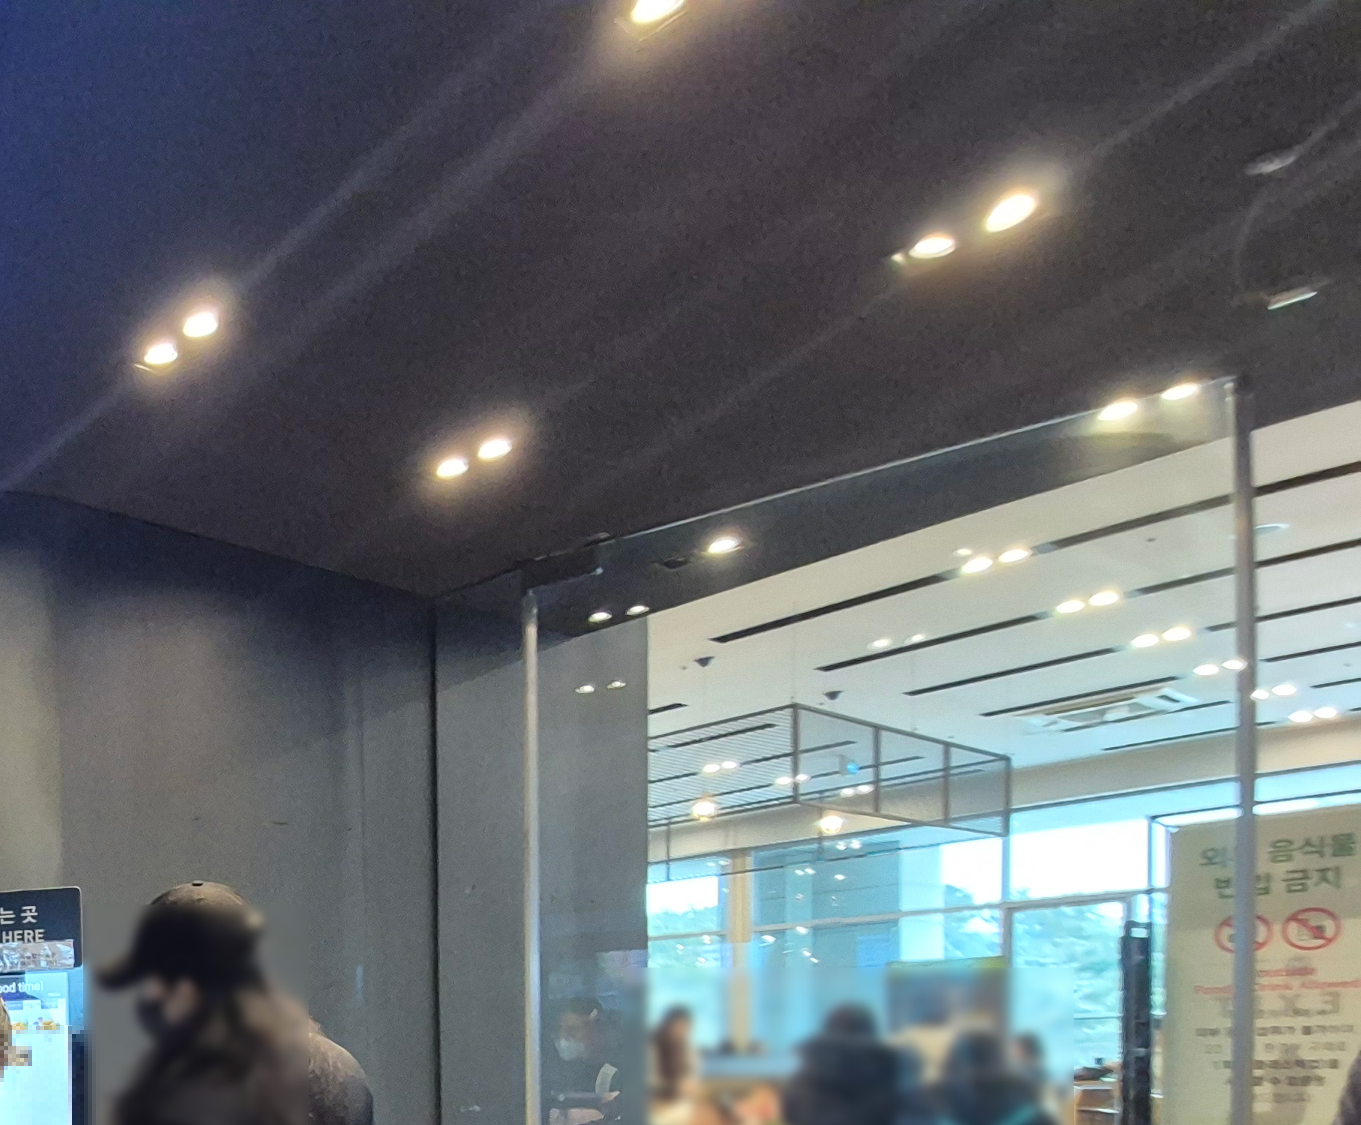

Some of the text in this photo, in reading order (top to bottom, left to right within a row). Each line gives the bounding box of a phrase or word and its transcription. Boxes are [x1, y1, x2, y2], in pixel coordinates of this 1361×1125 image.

[1281, 866, 1342, 894] 금지
[20, 905, 39, 925] 곳
[2, 928, 46, 944] HERE
[18, 980, 44, 992] time!
